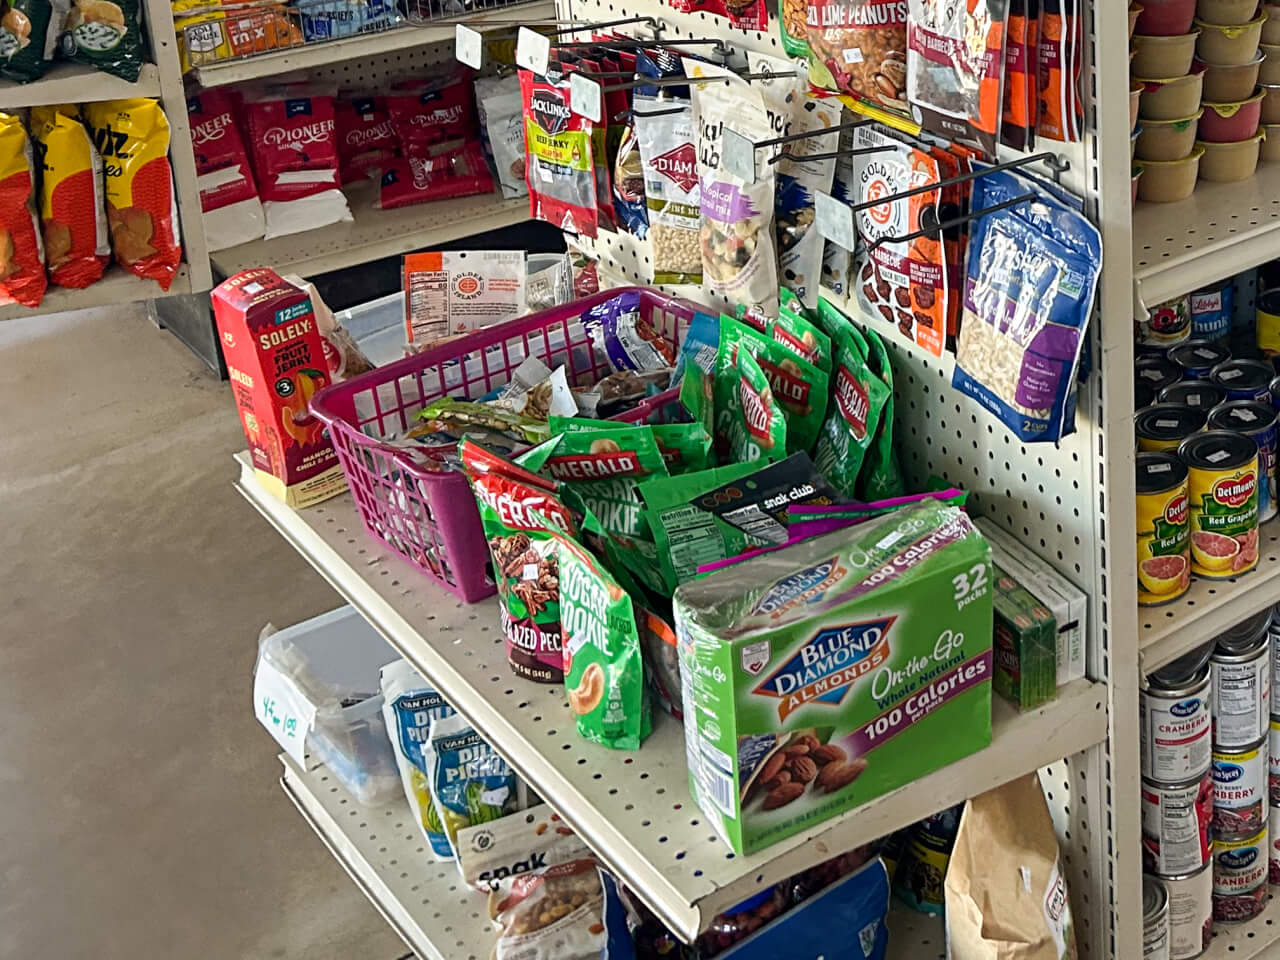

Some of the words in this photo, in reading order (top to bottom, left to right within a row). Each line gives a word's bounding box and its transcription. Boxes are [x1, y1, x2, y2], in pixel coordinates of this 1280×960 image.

[821, 4, 846, 25] LIME
[848, 2, 907, 24] PEANUTS
[263, 119, 335, 145] PIONEER
[278, 310, 292, 321] 12
[274, 344, 309, 366] FRUIT
[275, 355, 312, 378] JERKY
[280, 382, 290, 392] 3
[763, 493, 791, 510] snak
[792, 483, 814, 501] club
[1217, 486, 1230, 498] Del
[1230, 480, 1256, 496] Monte
[1209, 515, 1224, 525] Red
[1161, 536, 1174, 548] Red
[862, 563, 897, 590] 100
[894, 521, 961, 573] Calories
[561, 561, 610, 624] SUGAR
[952, 563, 988, 601] 32
[957, 586, 988, 611] packs
[561, 597, 614, 657] COOKIE
[799, 628, 854, 665] BLUE
[774, 627, 884, 694] DIAMOND
[871, 629, 965, 701] On-the-Go
[787, 651, 884, 712] ALMONDS
[876, 685, 917, 711] Whole
[919, 650, 966, 687] Natural
[863, 707, 902, 740] 100
[904, 660, 987, 717] Calories
[926, 696, 945, 714] pack
[1159, 713, 1208, 733] CRANBERRY
[458, 744, 492, 764] DILL
[479, 851, 548, 893] snak
